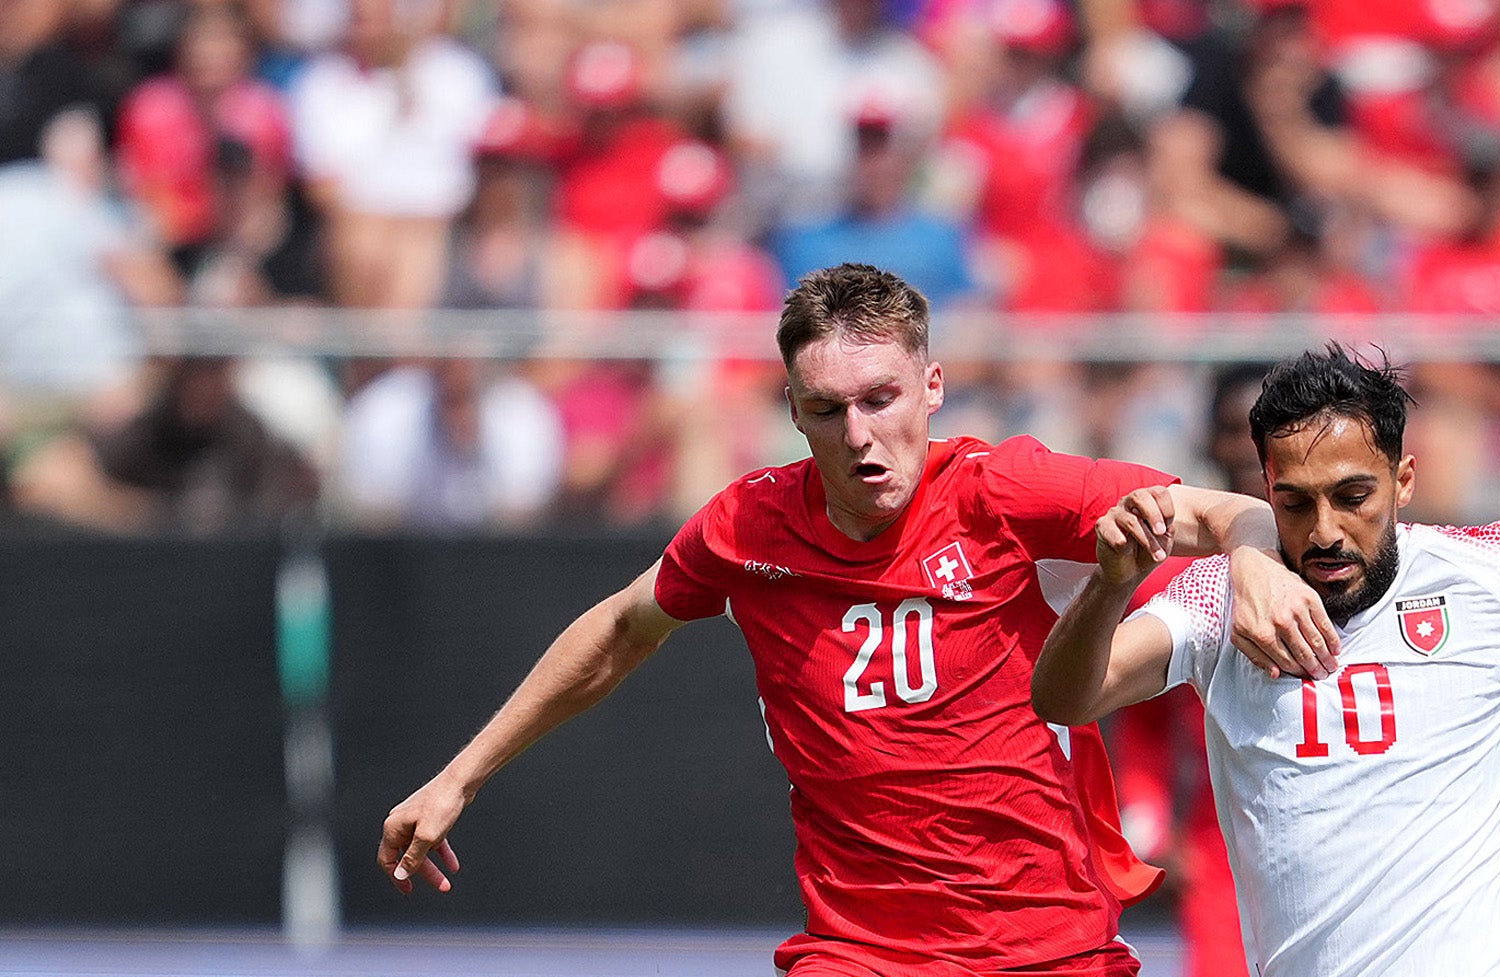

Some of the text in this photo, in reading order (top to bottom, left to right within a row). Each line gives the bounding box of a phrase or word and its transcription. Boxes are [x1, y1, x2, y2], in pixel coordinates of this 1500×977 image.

[1402, 598, 1440, 610] JORDAN
[843, 597, 938, 712] 20
[1295, 662, 1398, 758] 10
